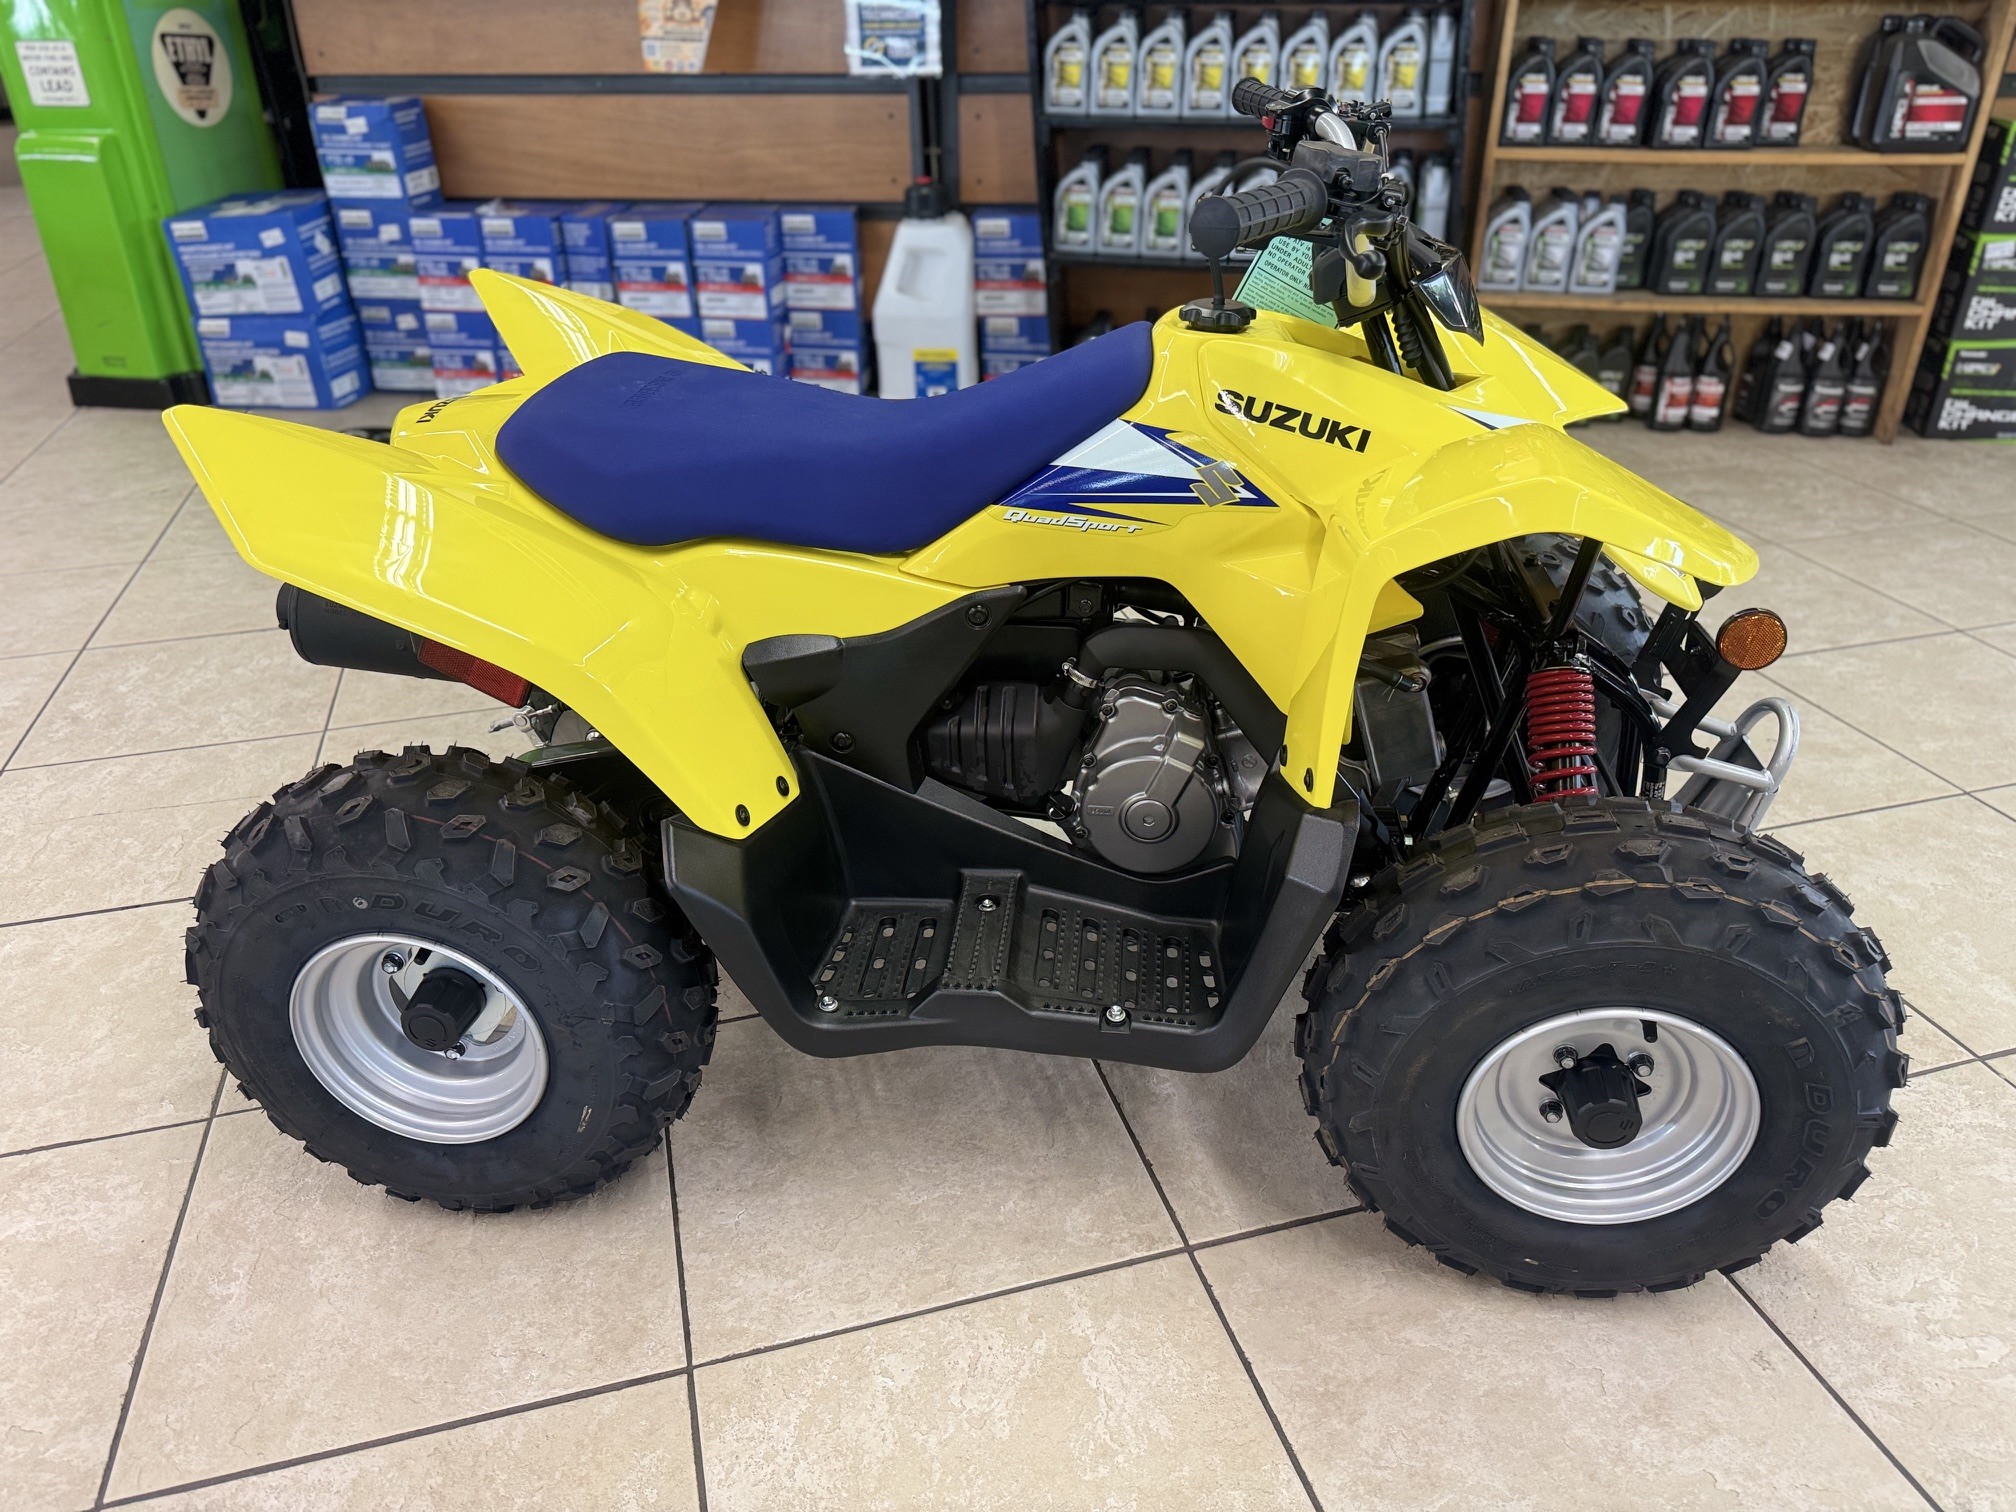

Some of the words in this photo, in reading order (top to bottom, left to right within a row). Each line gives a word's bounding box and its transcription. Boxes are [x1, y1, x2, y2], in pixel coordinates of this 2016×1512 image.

[39, 80, 74, 93] LEAD
[1270, 243, 1292, 258] UNDER
[1277, 238, 1290, 248] USE
[1290, 245, 1299, 253] BY
[1300, 251, 1313, 261] YOU
[1263, 259, 1290, 278] OPERATOR
[1267, 250, 1276, 259] NO
[1276, 255, 1306, 276] OPERATOR
[1214, 389, 1372, 454] SUZUKI
[1003, 509, 1143, 534] QuadSport
[368, 890, 542, 972] DURO
[1753, 1079, 1835, 1221] DURO
